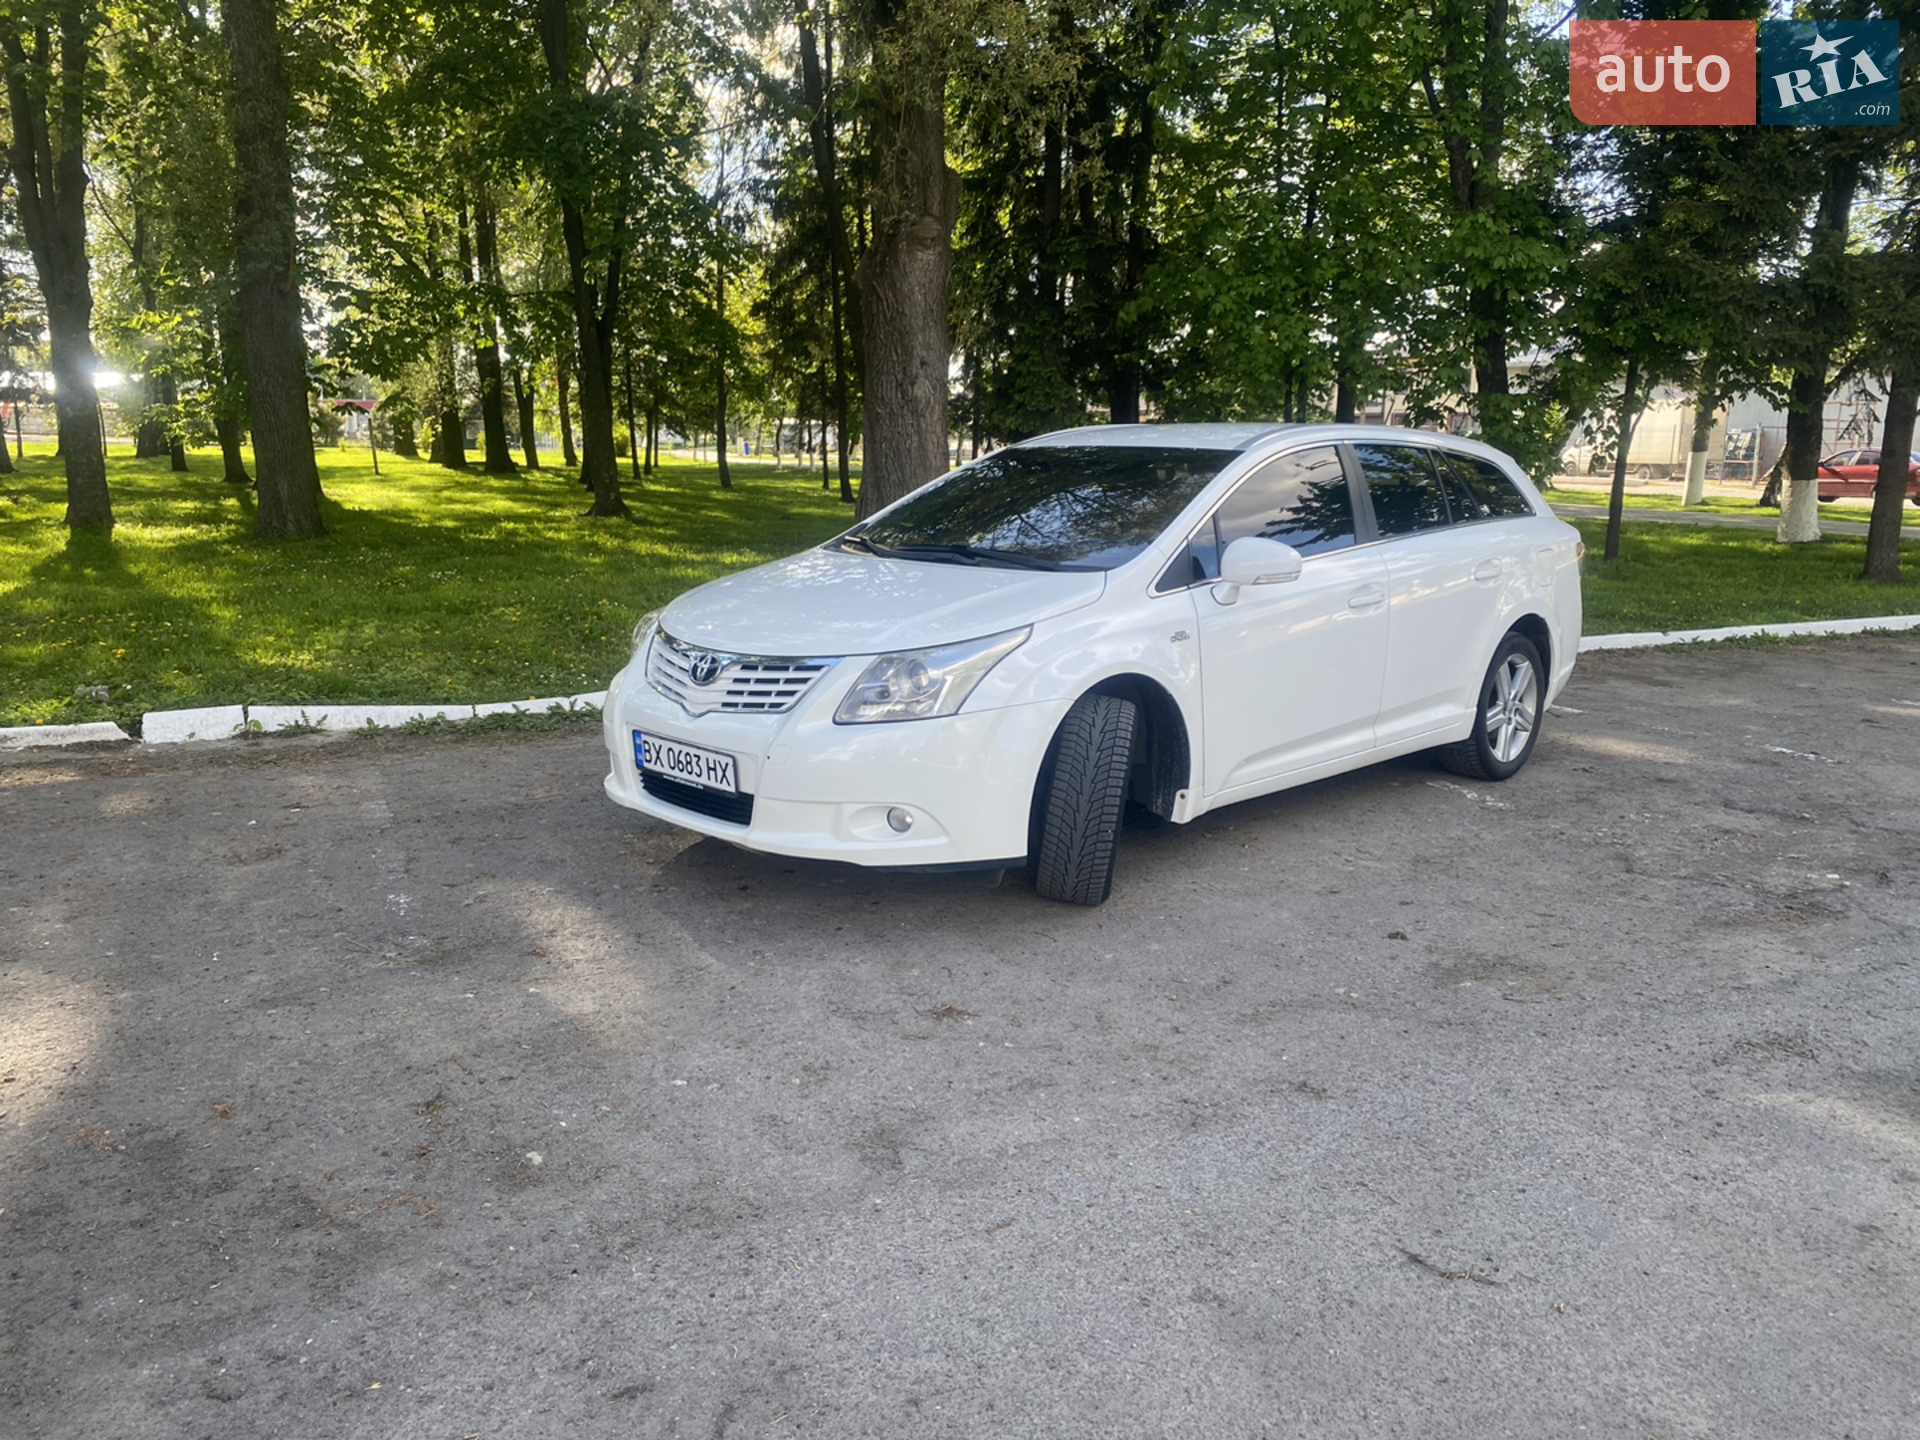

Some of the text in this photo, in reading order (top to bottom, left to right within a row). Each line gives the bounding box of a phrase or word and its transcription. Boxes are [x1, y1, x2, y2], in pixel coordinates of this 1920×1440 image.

[642, 739, 664, 769] BX
[667, 747, 703, 777] 0683
[706, 757, 731, 787] HX
